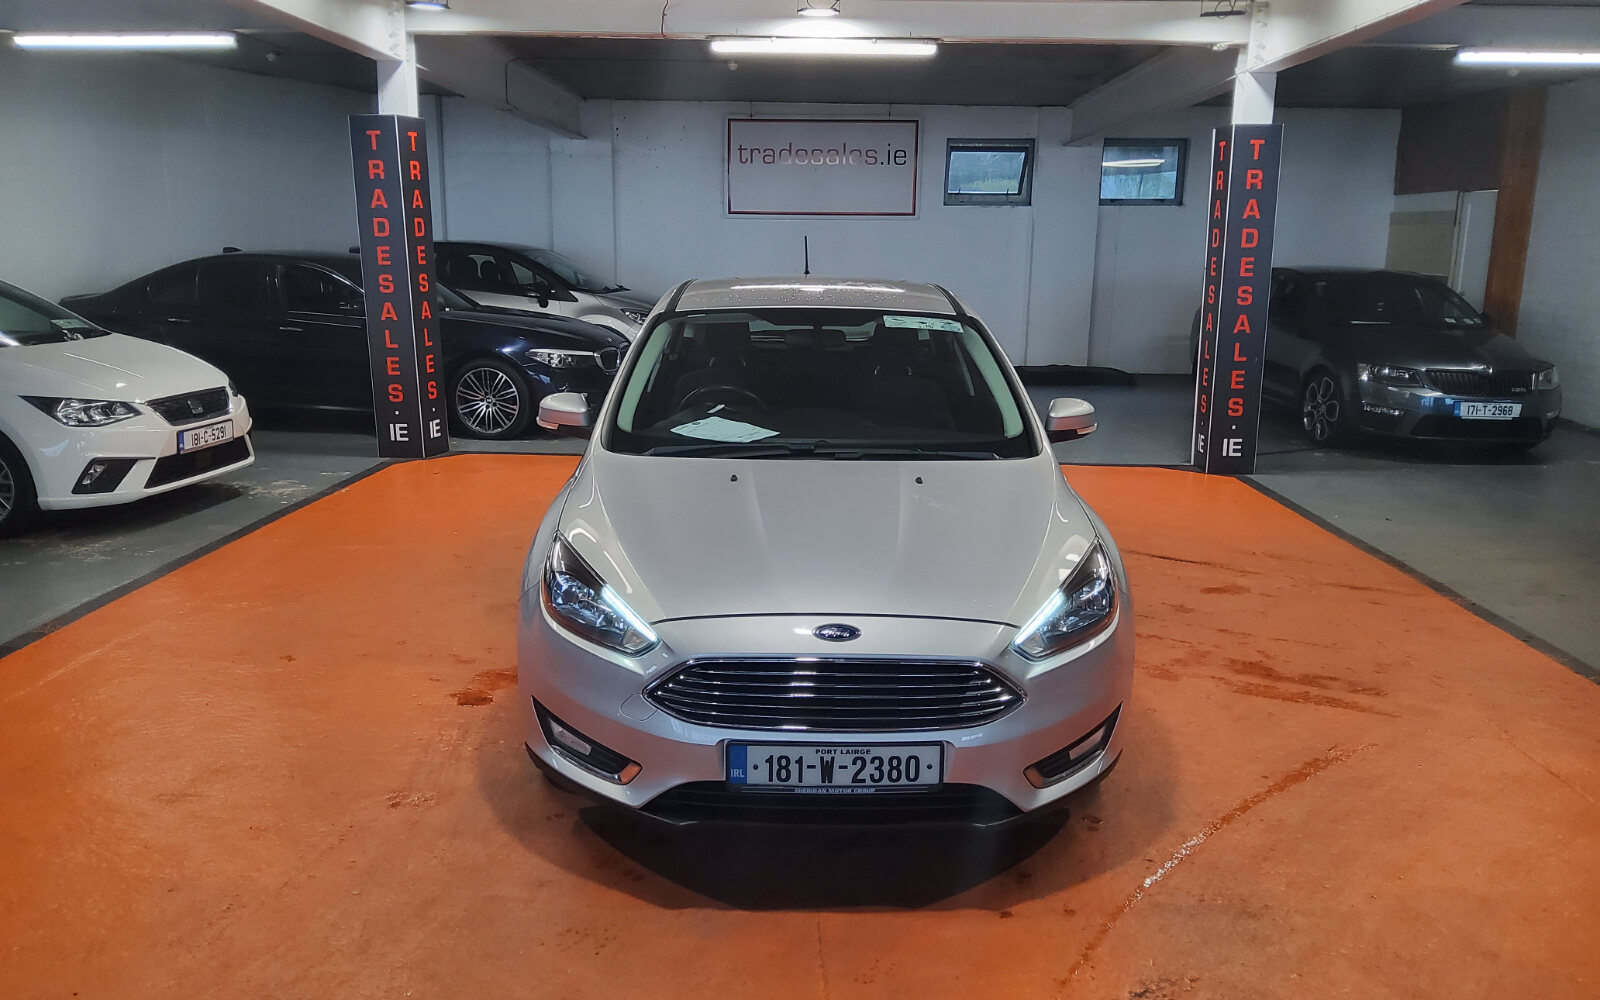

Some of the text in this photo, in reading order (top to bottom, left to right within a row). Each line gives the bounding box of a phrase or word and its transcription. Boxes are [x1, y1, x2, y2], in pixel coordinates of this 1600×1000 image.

[737, 142, 907, 165] tradesales.ie
[1467, 405, 1514, 416] 171-T-2968
[191, 425, 227, 447] 181-C-5291
[730, 769, 745, 778] IRL
[764, 754, 920, 784] 181-W-2380
